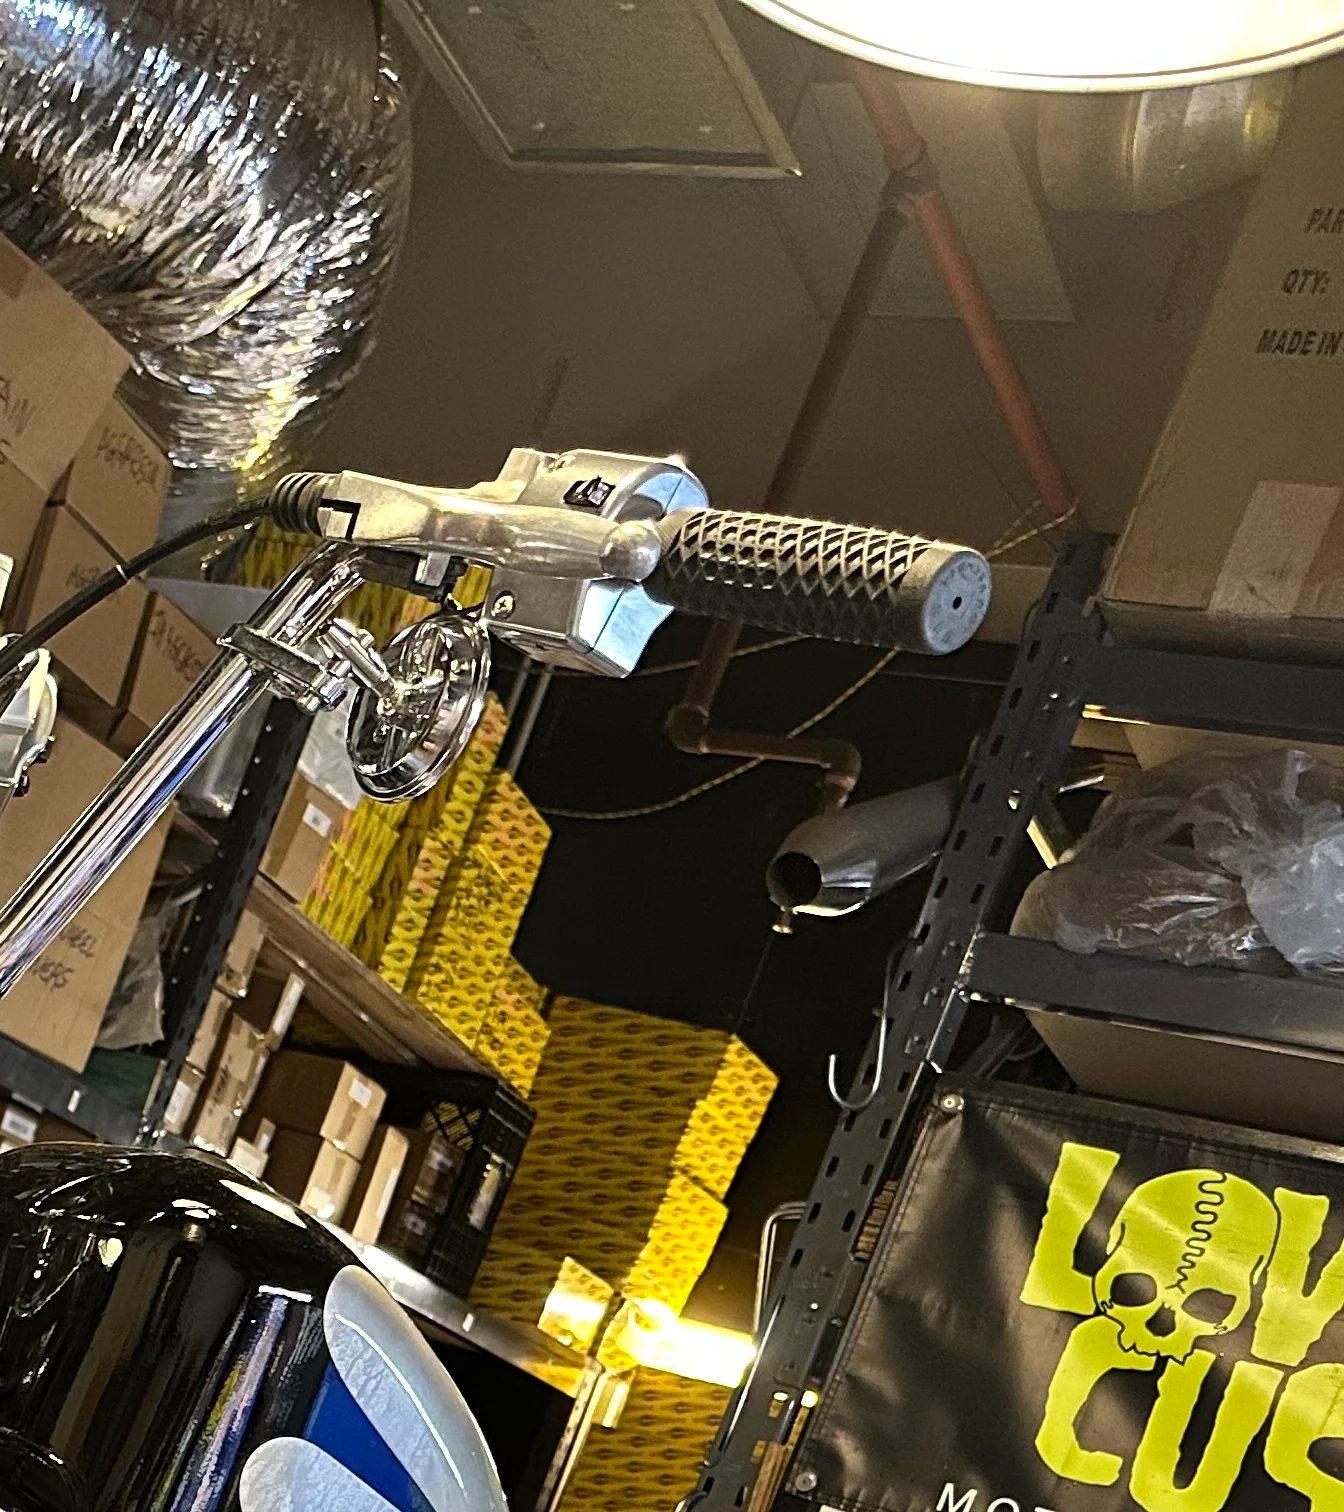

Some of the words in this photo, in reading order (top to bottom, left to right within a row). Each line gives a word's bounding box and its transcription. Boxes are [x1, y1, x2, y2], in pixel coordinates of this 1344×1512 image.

[1282, 268, 1330, 296] QTY:
[1256, 328, 1316, 356] MADE
[1315, 331, 1344, 356] IN
